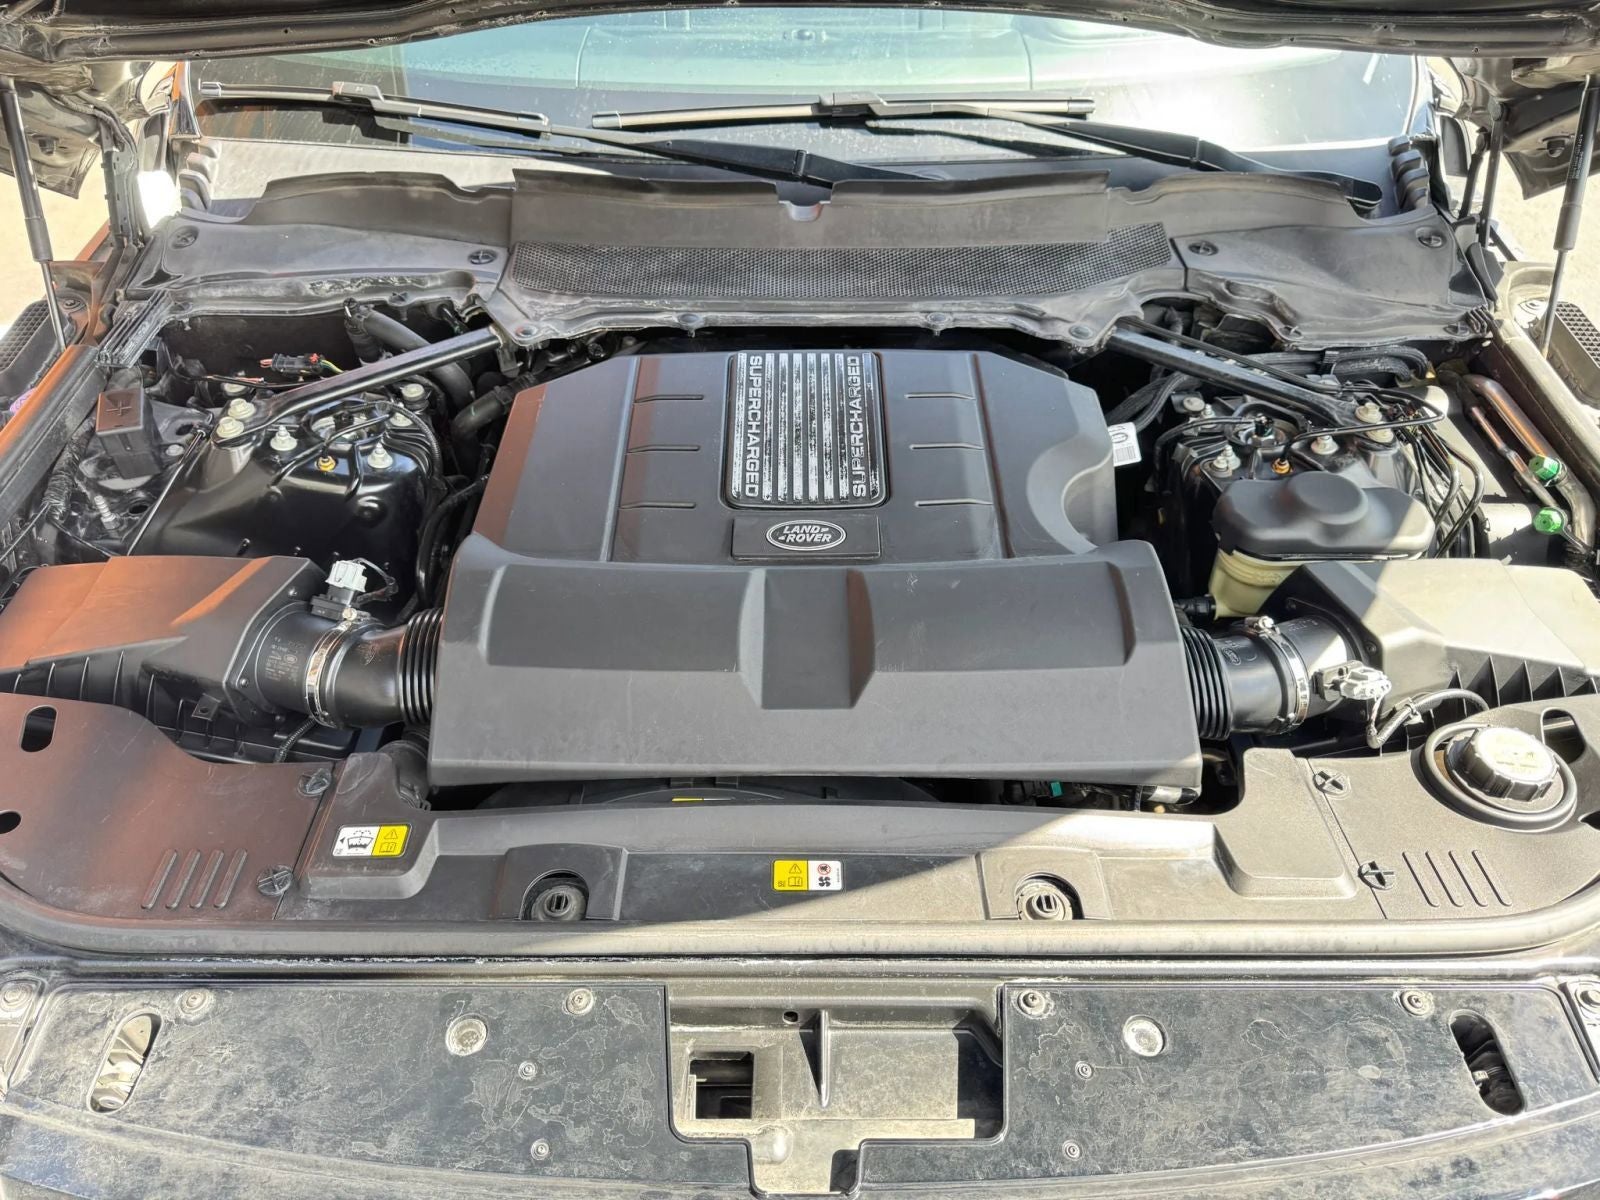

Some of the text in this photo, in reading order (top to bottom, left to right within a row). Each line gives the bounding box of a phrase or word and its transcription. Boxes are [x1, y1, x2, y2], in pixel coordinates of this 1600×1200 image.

[745, 355, 762, 497] SUPERCHARGED
[847, 355, 867, 497] SUPERCHARGED
[783, 525, 821, 534] LAND
[786, 533, 832, 543] ROVER
